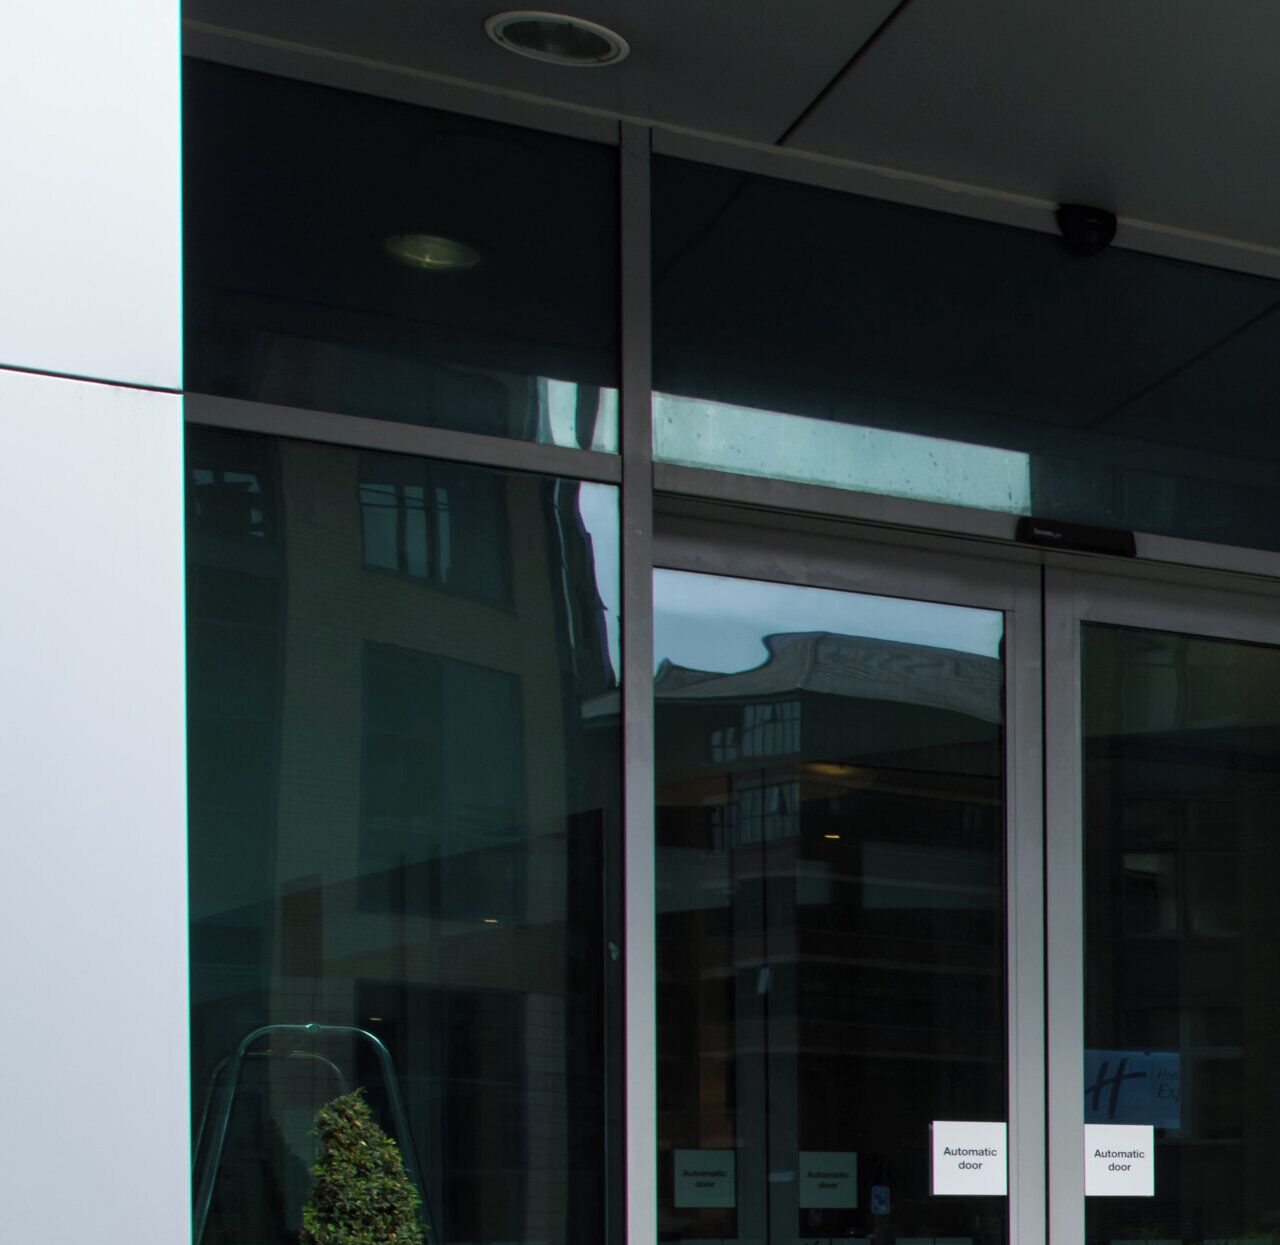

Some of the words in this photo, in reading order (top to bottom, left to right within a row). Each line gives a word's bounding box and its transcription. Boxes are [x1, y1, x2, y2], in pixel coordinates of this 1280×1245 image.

[943, 1146, 998, 1157] Automatic
[1094, 1148, 1145, 1159] Automatic
[958, 1160, 983, 1171] door
[1108, 1162, 1132, 1172] door
[682, 1169, 728, 1178] Automatic
[694, 1180, 716, 1189] door
